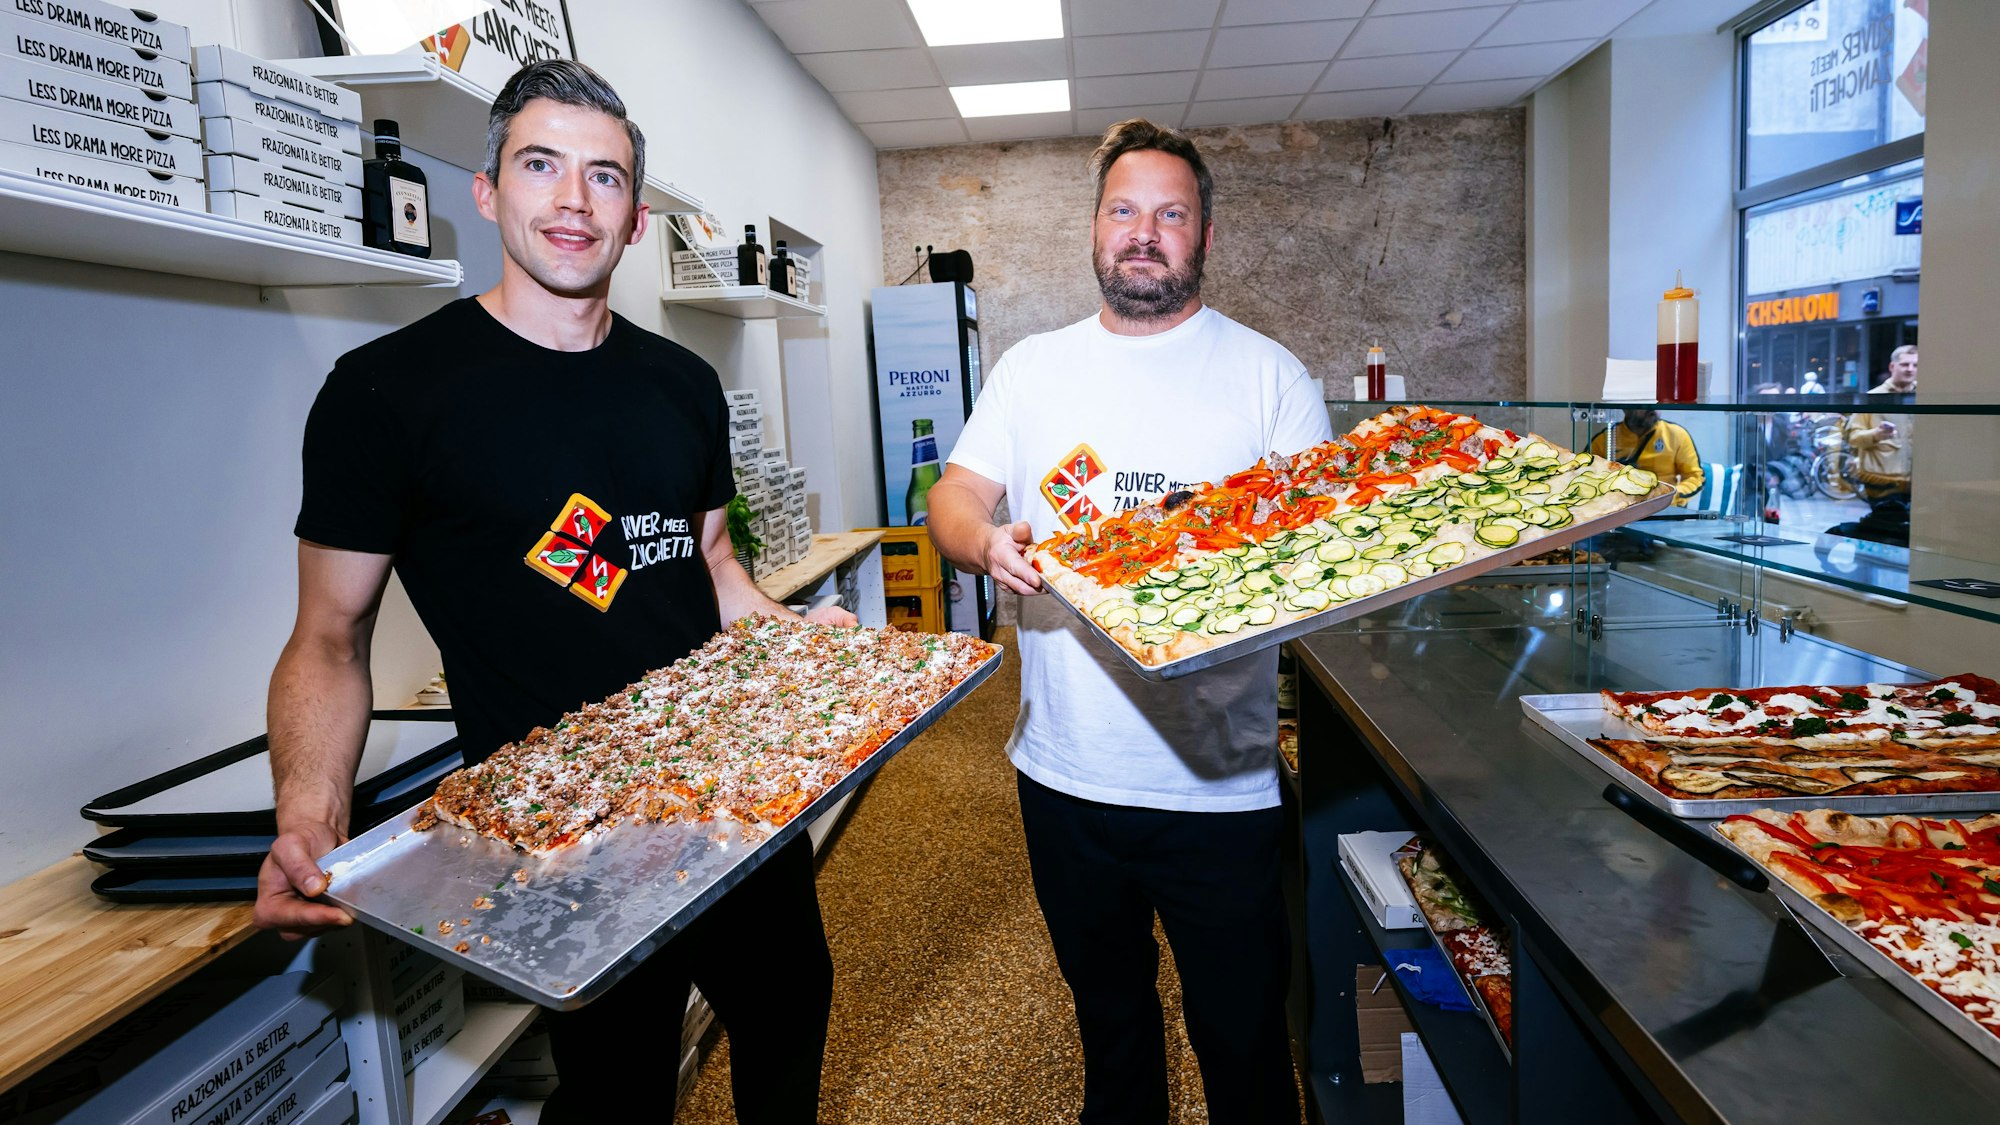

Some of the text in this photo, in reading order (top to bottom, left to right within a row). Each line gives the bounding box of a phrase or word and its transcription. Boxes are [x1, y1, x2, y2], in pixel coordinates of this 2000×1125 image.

[47, 2, 91, 30] DRAMA
[95, 17, 129, 41] MORE
[17, 35, 46, 58] LESS
[50, 44, 93, 71] DRAMA
[97, 58, 130, 81] MORE
[28, 79, 57, 101] LESS
[60, 88, 103, 113] DRAMA
[106, 99, 140, 121] MORE
[313, 86, 339, 105] BETTER
[314, 120, 339, 139] BETTER
[33, 124, 61, 145] LESS
[64, 132, 107, 156] DRAMA
[110, 142, 144, 163] MORE
[319, 154, 342, 172] BETTER
[319, 187, 342, 203] BETTER
[319, 223, 342, 239] BETTER
[889, 369, 950, 386] PERONI
[1114, 472, 1165, 493] RUVER
[423, 970, 445, 993] BETTER
[420, 999, 443, 1025] BETTER
[256, 1022, 290, 1058] BETTER
[421, 1024, 444, 1049] BETTER
[254, 1059, 286, 1097] BETTER
[266, 1092, 298, 1125] BETTER
